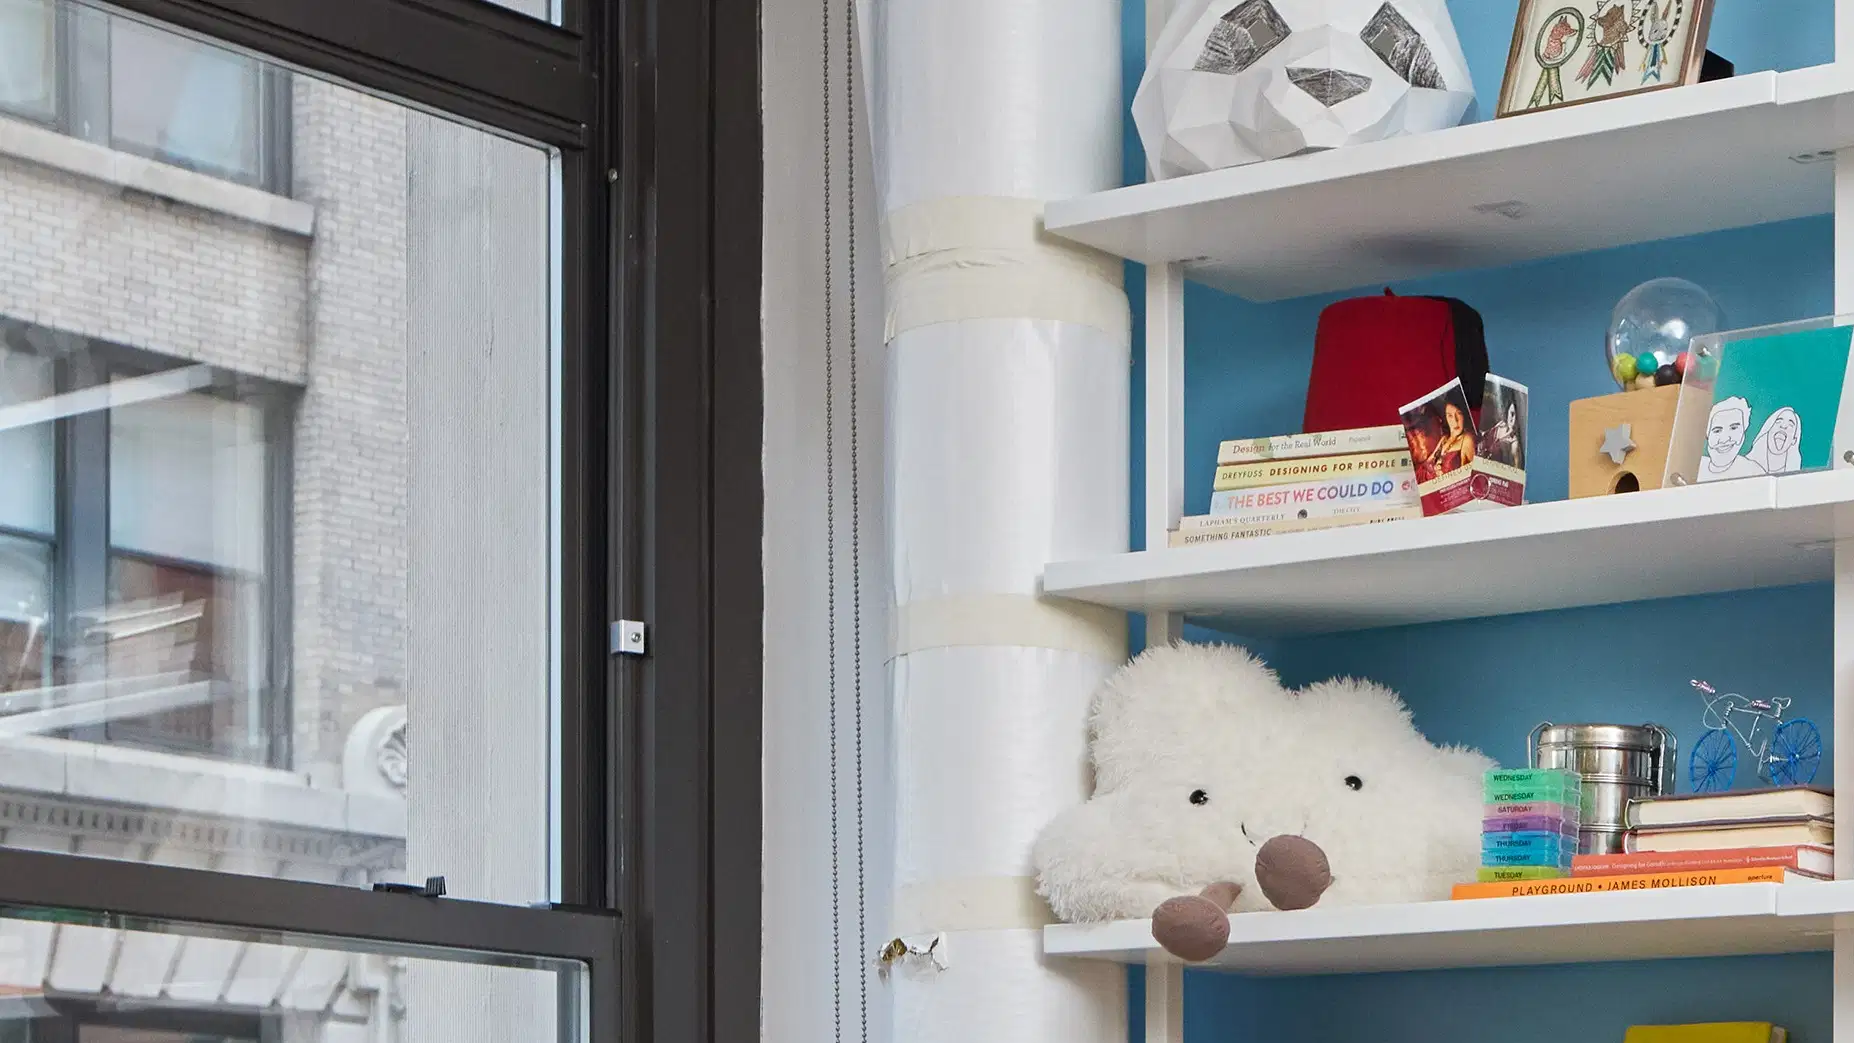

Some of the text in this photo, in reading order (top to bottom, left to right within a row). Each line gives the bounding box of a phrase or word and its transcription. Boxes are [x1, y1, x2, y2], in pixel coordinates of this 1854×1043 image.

[1232, 436, 1337, 455] Design for the Real World
[1222, 458, 1397, 480] DREYFUSS DESIGNING FOR PEOPLE
[1227, 480, 1394, 510] THE BEST WE COULD DO
[1199, 512, 1286, 528] LAPHAM'S QUARTERLY
[1184, 532, 1229, 545] SOMETHING
[1230, 527, 1273, 542] FANTASTIC
[1493, 772, 1534, 783] WEDNESDAY
[1493, 791, 1535, 802] WEDNESDAY
[1498, 804, 1533, 814] SATURDAY
[1495, 839, 1532, 849] THURSDAY
[1494, 853, 1532, 863] THURSDAY
[1493, 870, 1523, 880] TUESDAY
[1746, 873, 1774, 883] aperture
[1511, 874, 1718, 898] PLAYGROUND JAMES MOLLISON
